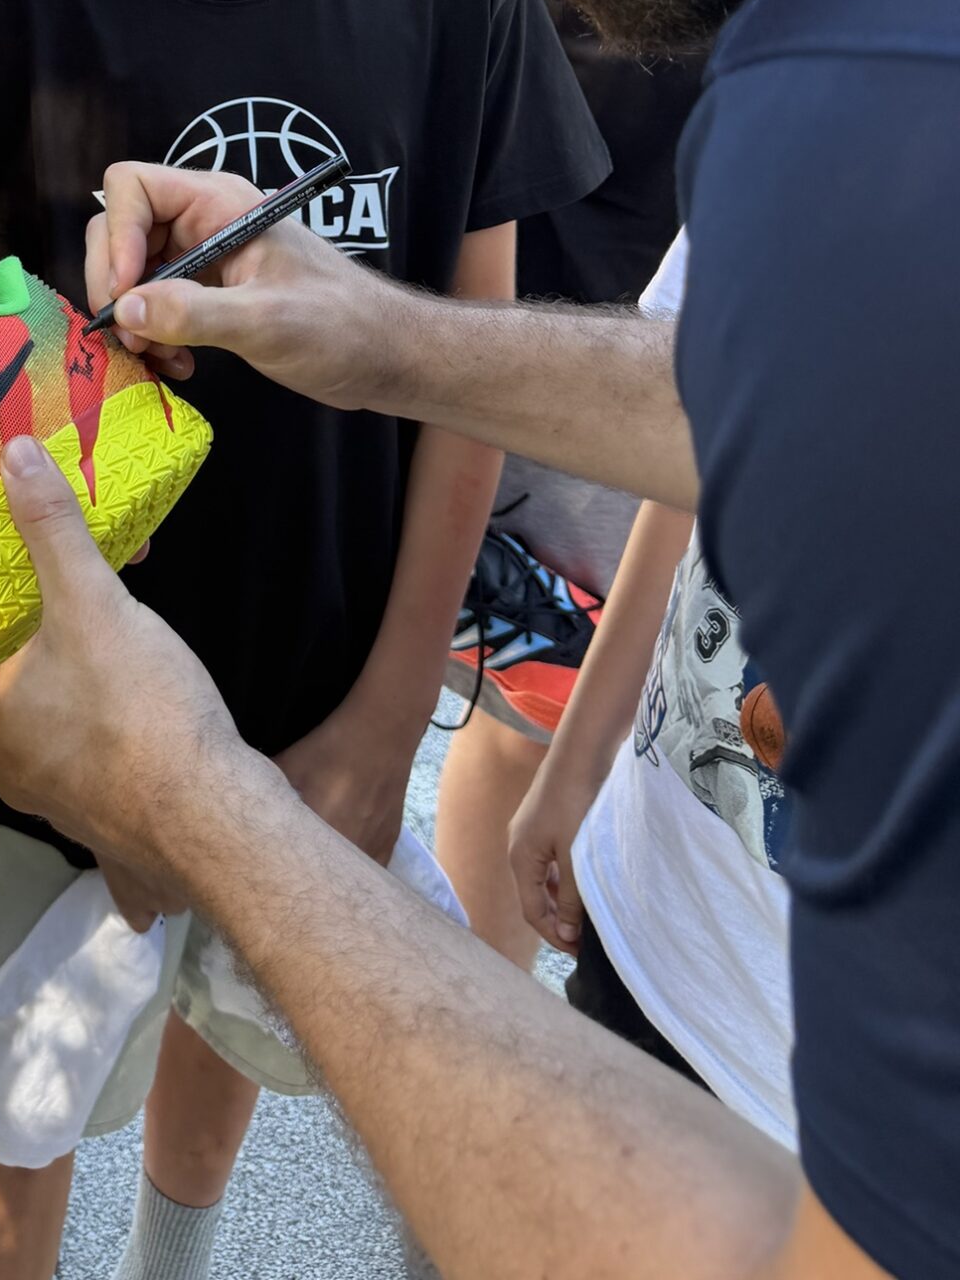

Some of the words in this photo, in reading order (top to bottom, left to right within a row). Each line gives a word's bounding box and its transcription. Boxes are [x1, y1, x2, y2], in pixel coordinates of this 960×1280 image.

[201, 216, 248, 252] permanent
[246, 205, 264, 224] pen
[693, 607, 731, 663] 3
